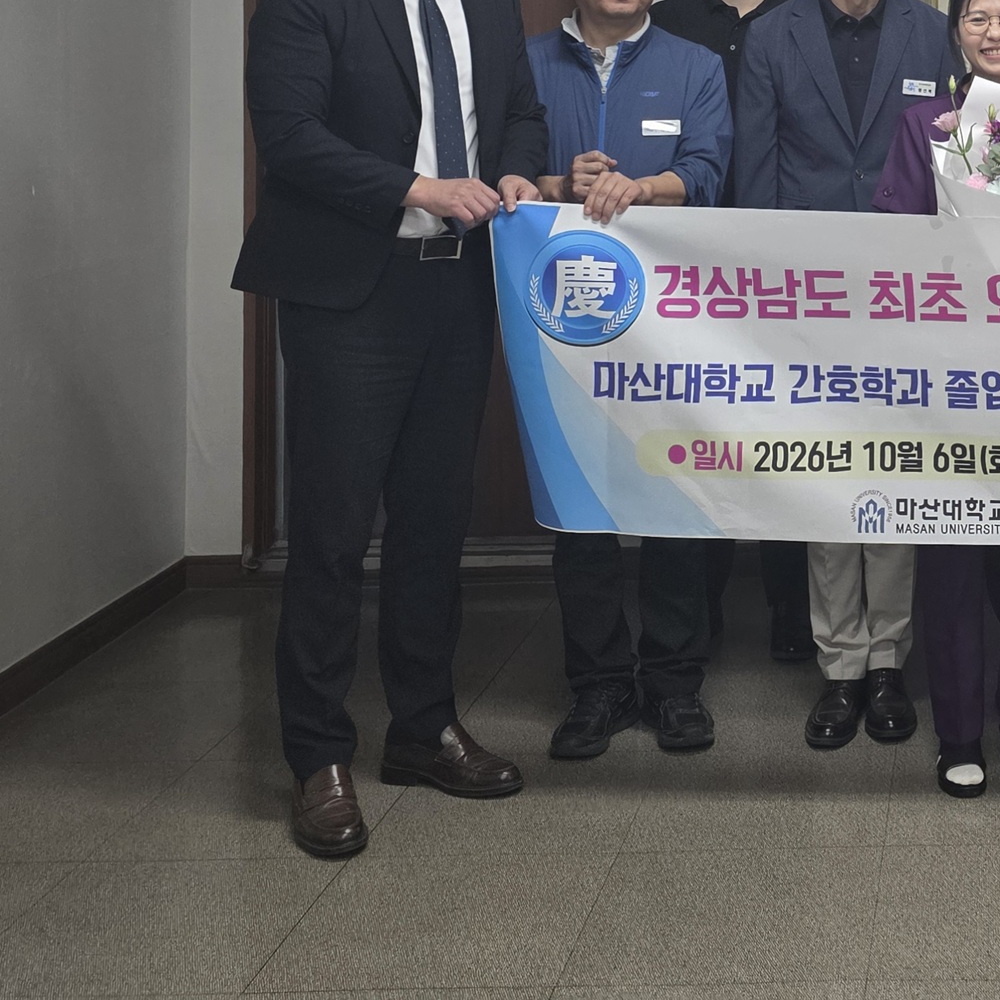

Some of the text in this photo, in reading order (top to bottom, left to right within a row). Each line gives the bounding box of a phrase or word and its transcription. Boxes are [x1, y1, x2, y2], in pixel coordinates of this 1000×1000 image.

[551, 255, 617, 320] 慶
[654, 265, 851, 320] 경상남도
[868, 270, 968, 323] 최초
[593, 360, 776, 405] 마산대학교
[788, 364, 934, 408] 간호학과
[691, 439, 743, 472] 일시
[753, 440, 852, 473] 2026년
[862, 441, 923, 473] 10월
[895, 523, 936, 535] MASAN
